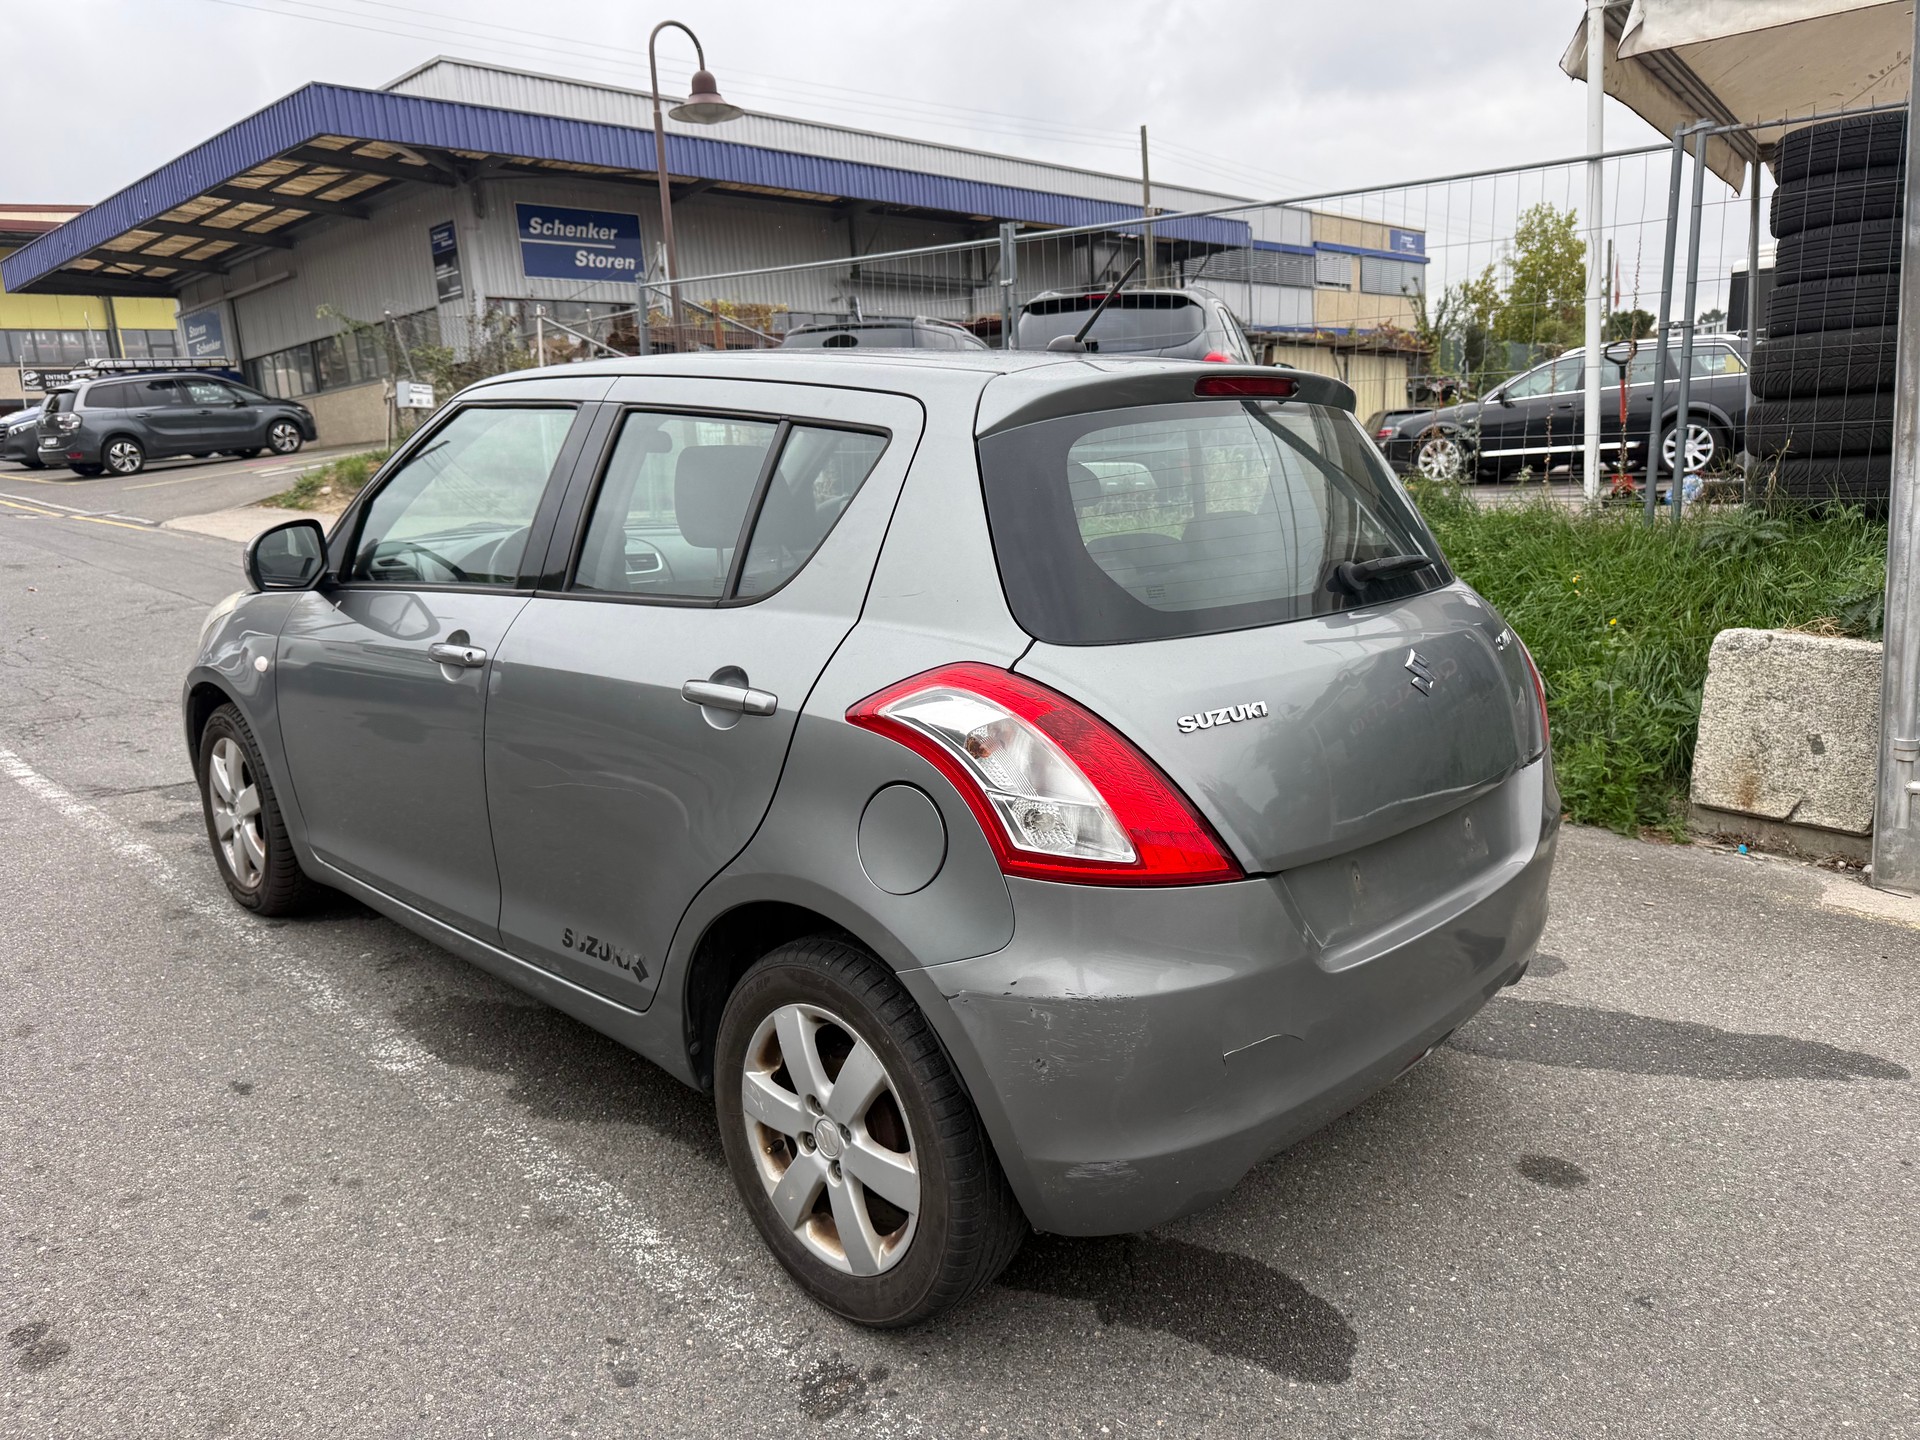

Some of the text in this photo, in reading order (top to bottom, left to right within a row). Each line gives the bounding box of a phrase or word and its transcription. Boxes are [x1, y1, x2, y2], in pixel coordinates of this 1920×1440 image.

[529, 217, 618, 240] Schenker
[575, 250, 636, 270] Storen
[196, 340, 221, 355] Schenker
[1177, 700, 1268, 734] SUZUKI
